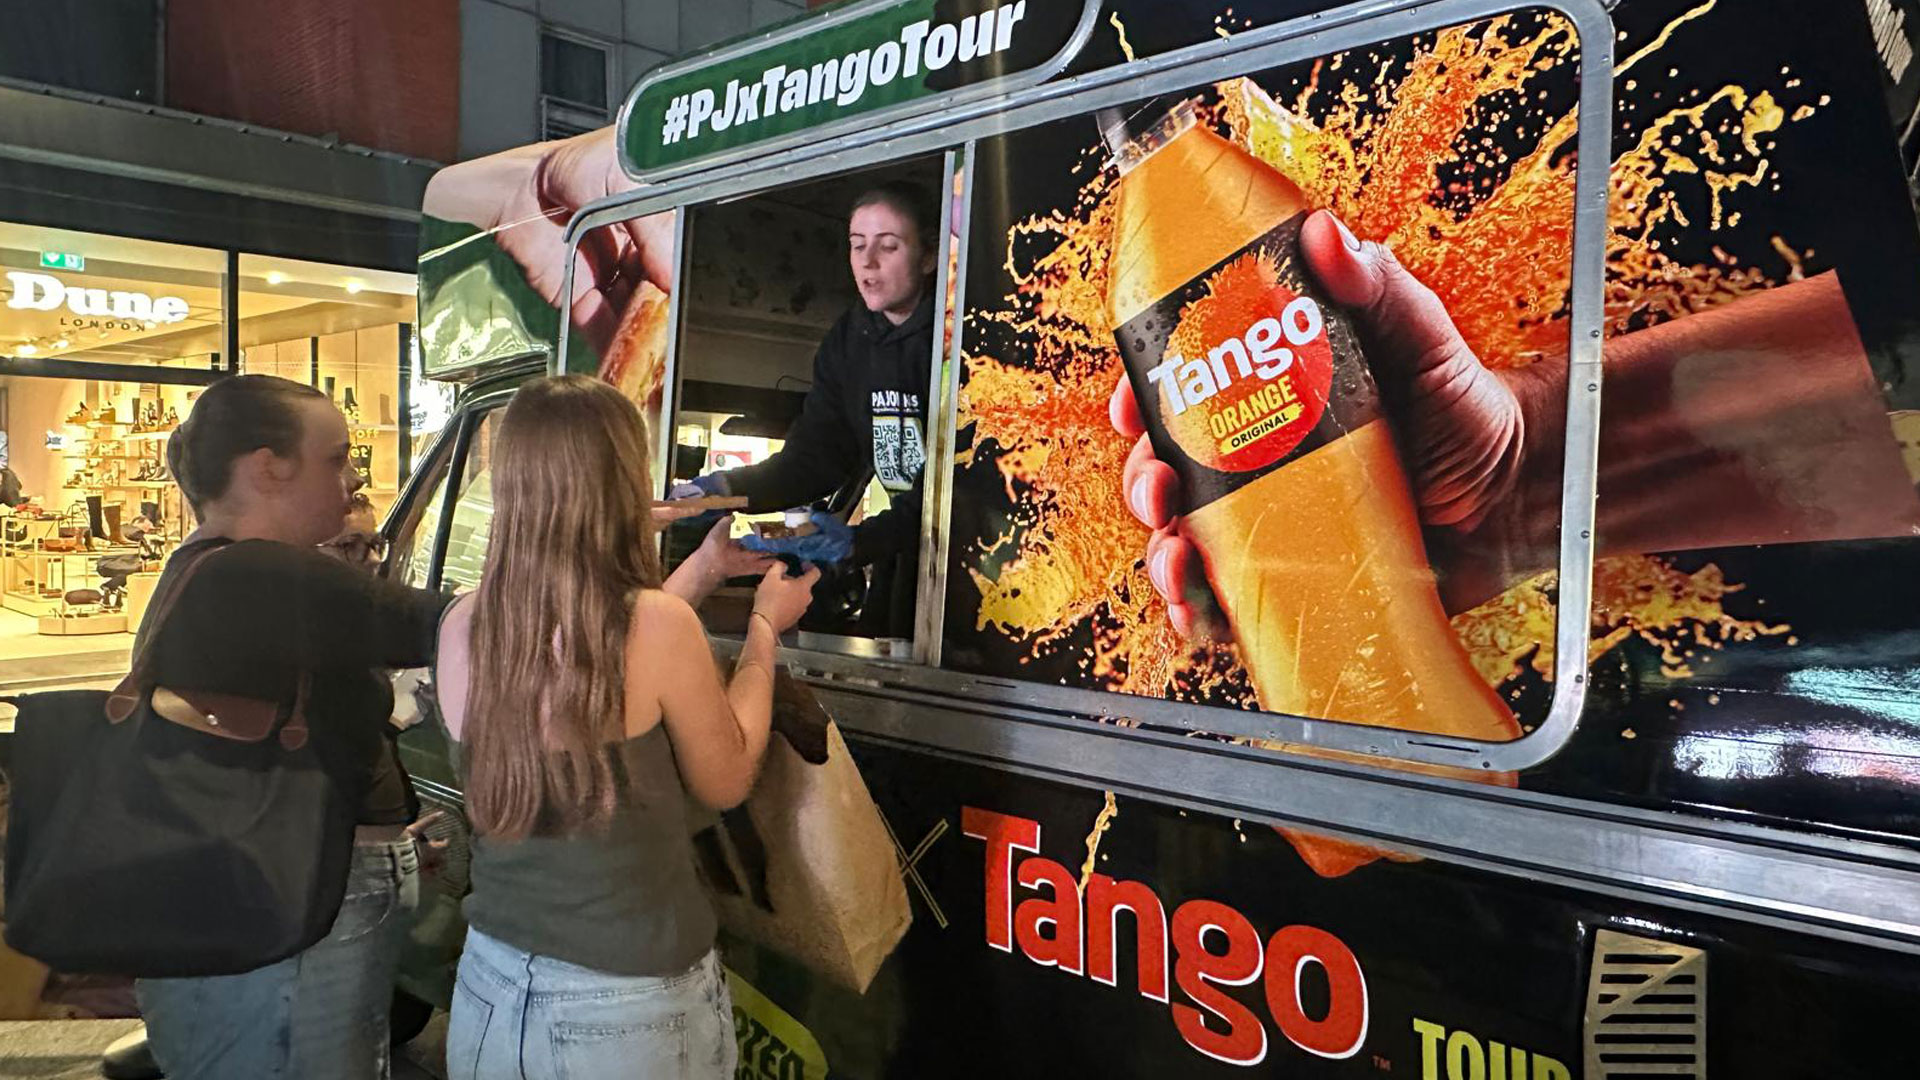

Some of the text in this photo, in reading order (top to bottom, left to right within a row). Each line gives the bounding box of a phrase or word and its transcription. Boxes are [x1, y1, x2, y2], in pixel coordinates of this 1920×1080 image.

[662, 0, 1025, 145] #PJxTangoTour
[6, 271, 190, 324] Dune
[60, 317, 146, 332] LONDON
[1147, 296, 1323, 416] Tango
[1209, 375, 1297, 439] ORANGE
[1231, 412, 1289, 448] ORIGINAL
[961, 806, 1369, 1067] Tango
